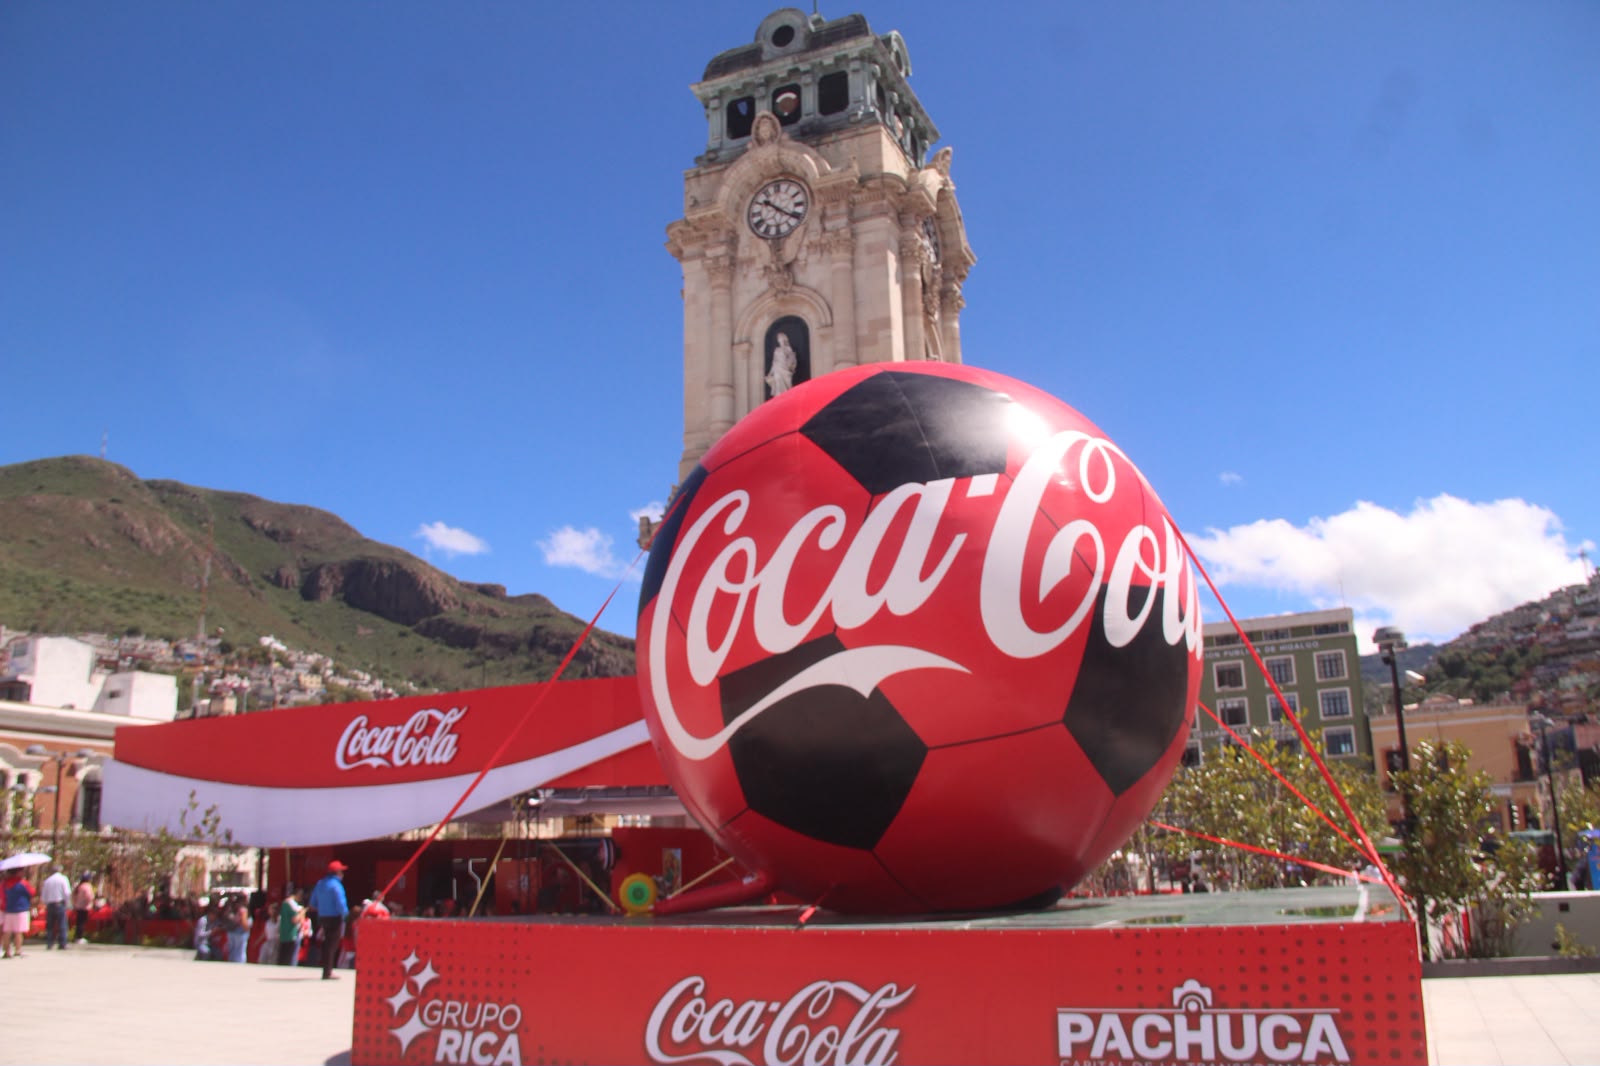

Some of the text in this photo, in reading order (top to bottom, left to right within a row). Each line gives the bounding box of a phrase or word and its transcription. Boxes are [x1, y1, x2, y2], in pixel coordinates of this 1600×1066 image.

[335, 705, 468, 770] Coca-Cola
[423, 999, 522, 1031] GRUPO
[645, 975, 916, 1066] Coca-Cola
[1057, 1012, 1351, 1062] PACHUCA
[434, 1029, 523, 1066] RICA
